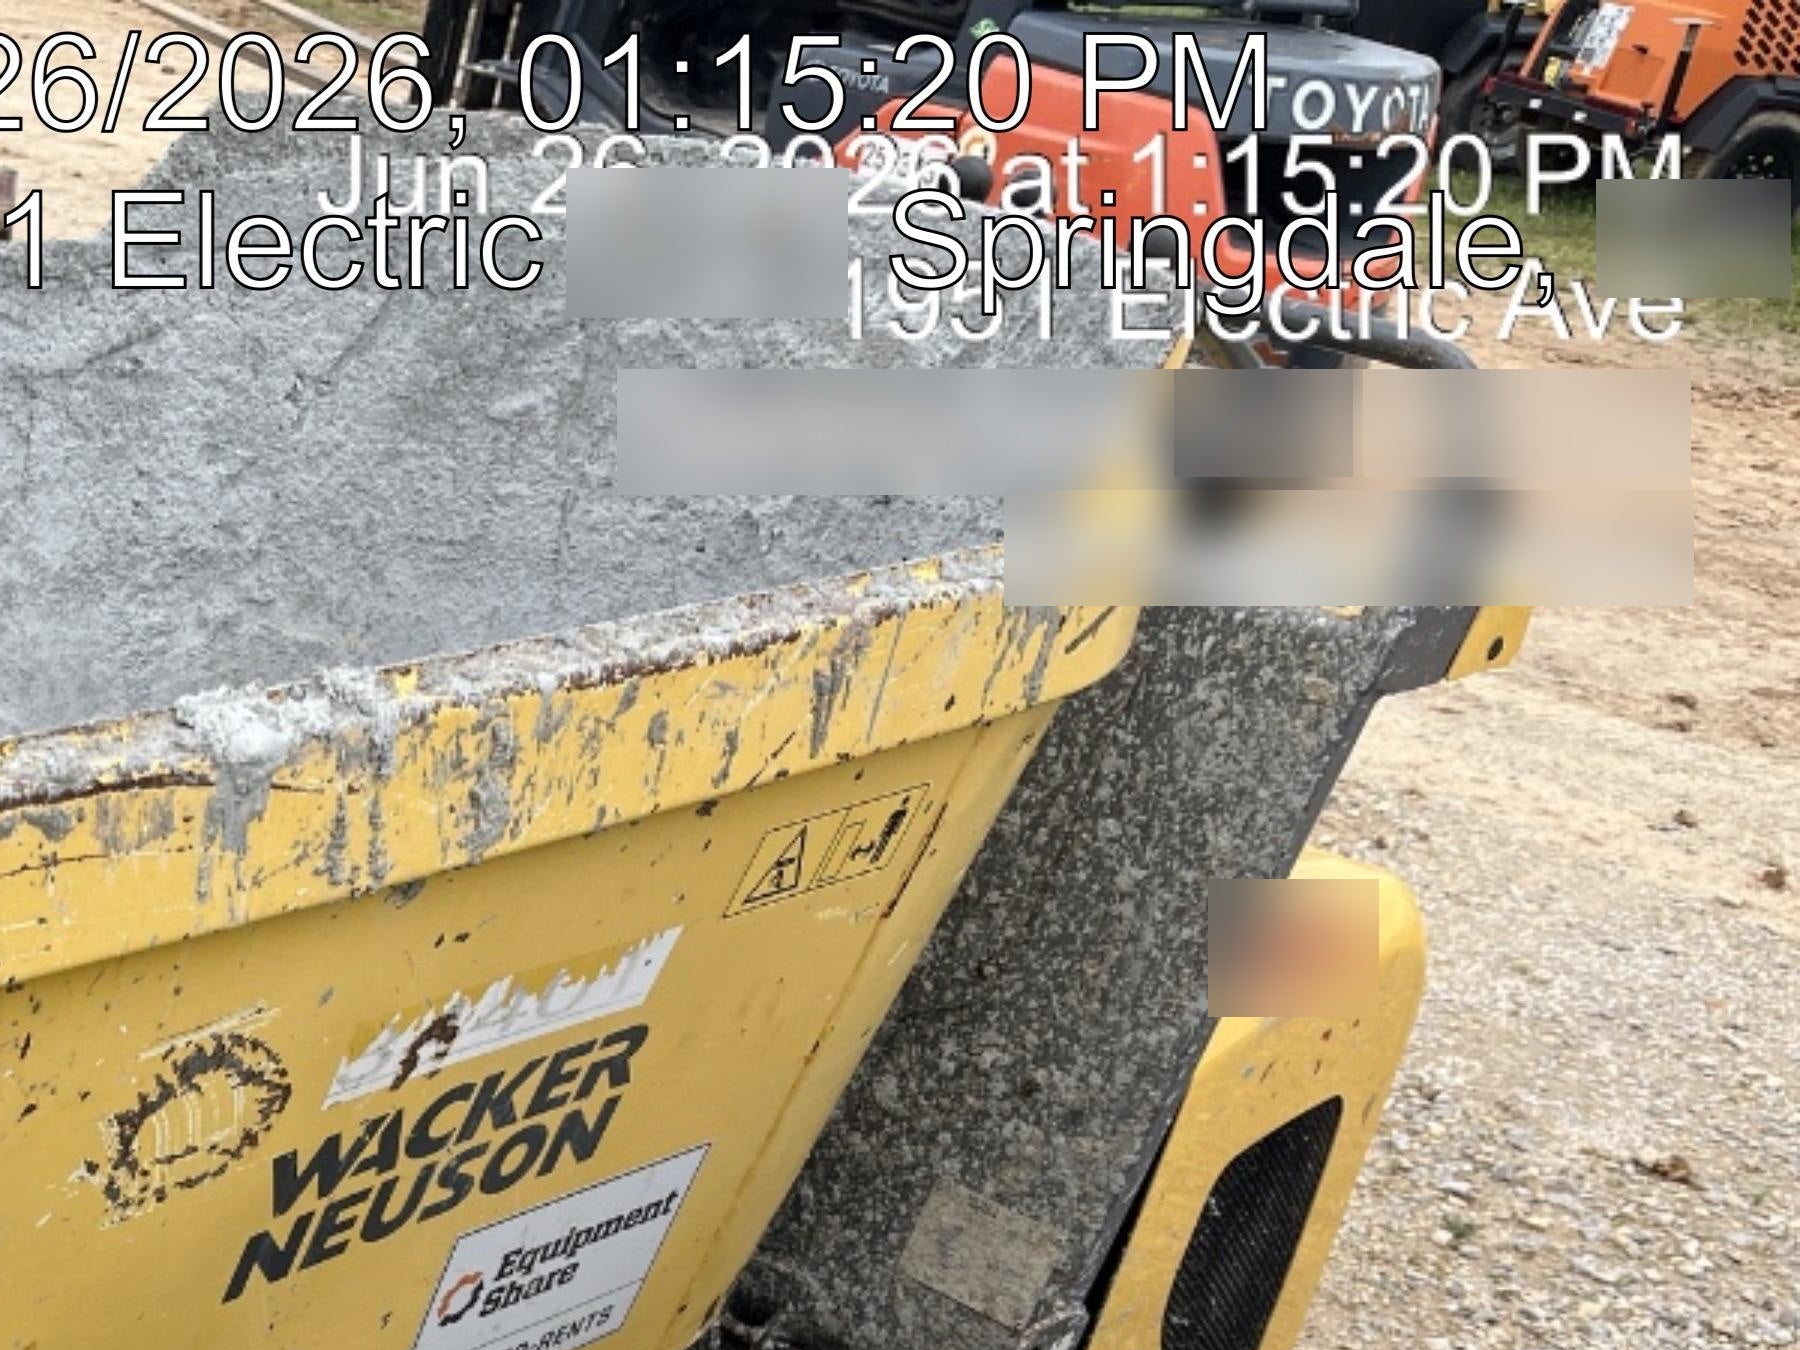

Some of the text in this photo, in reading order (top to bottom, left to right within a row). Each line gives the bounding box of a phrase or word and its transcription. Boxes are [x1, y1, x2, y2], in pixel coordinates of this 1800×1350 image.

[272, 1022, 650, 1219] WACKER
[221, 1094, 622, 1305] NEUSON
[493, 1190, 679, 1283] Equipment
[478, 1262, 580, 1318] Share
